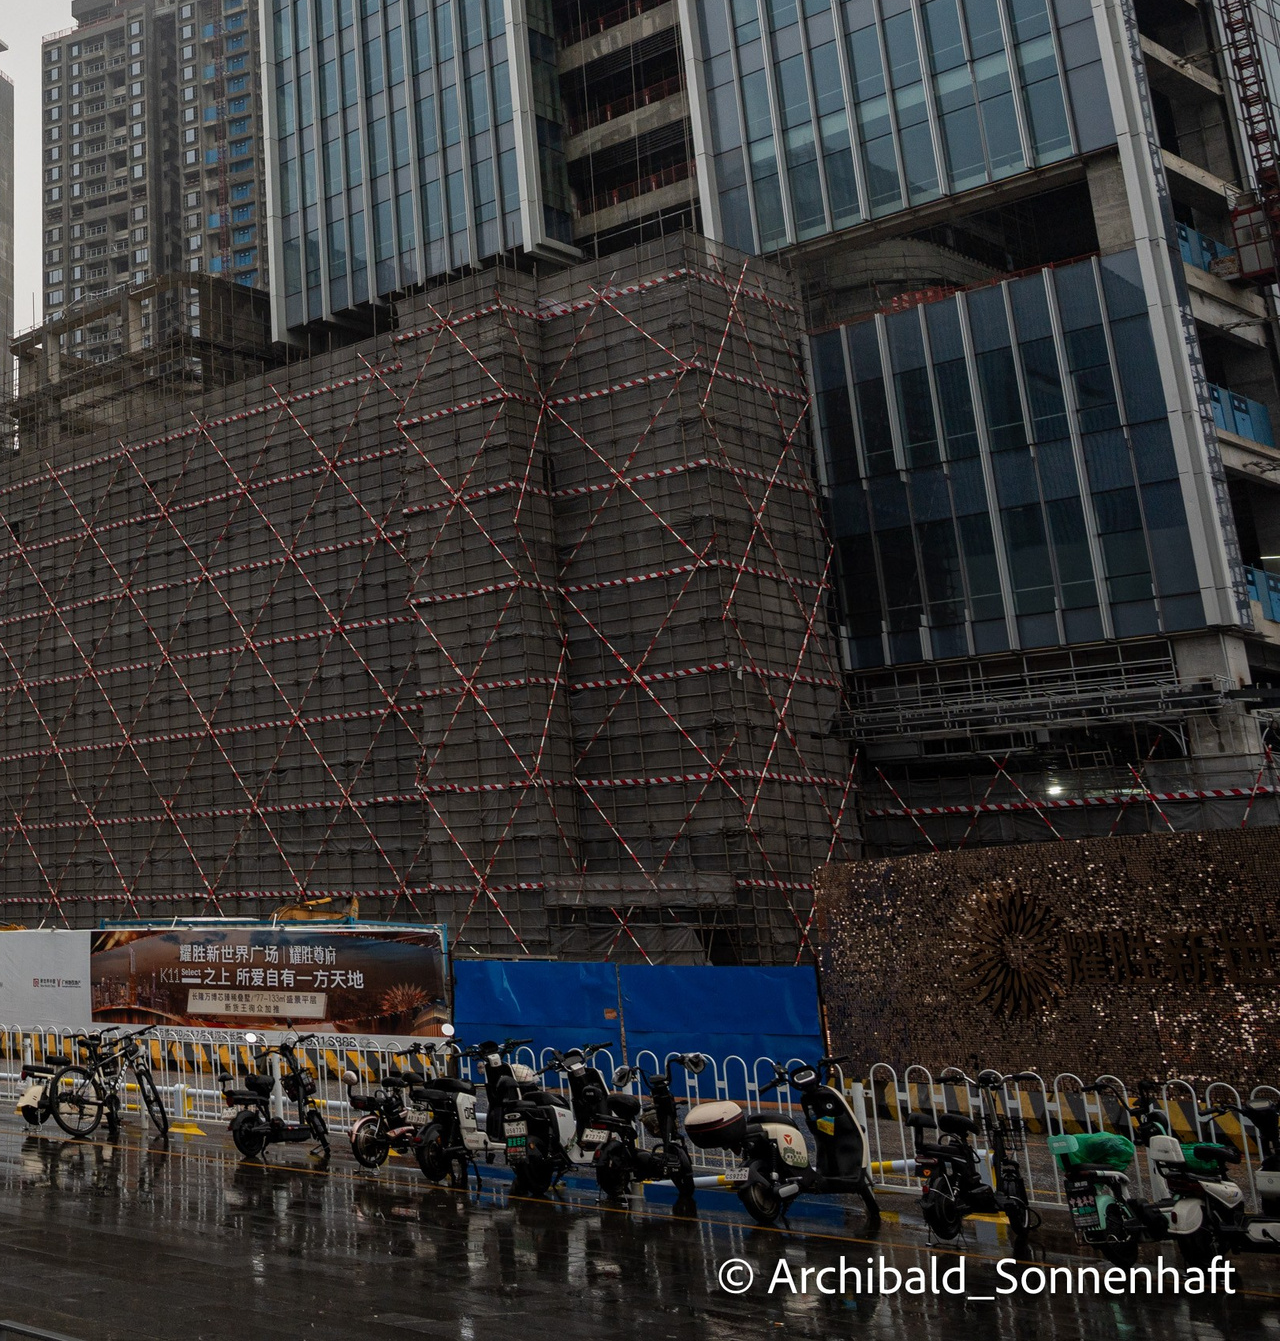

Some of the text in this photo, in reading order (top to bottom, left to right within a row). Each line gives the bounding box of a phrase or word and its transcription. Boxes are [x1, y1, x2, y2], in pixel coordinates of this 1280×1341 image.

[179, 944, 337, 966] 耀胜新世界广场 耀胜尊府
[160, 966, 365, 990] K11 Select 之上 所爱自有一方天地
